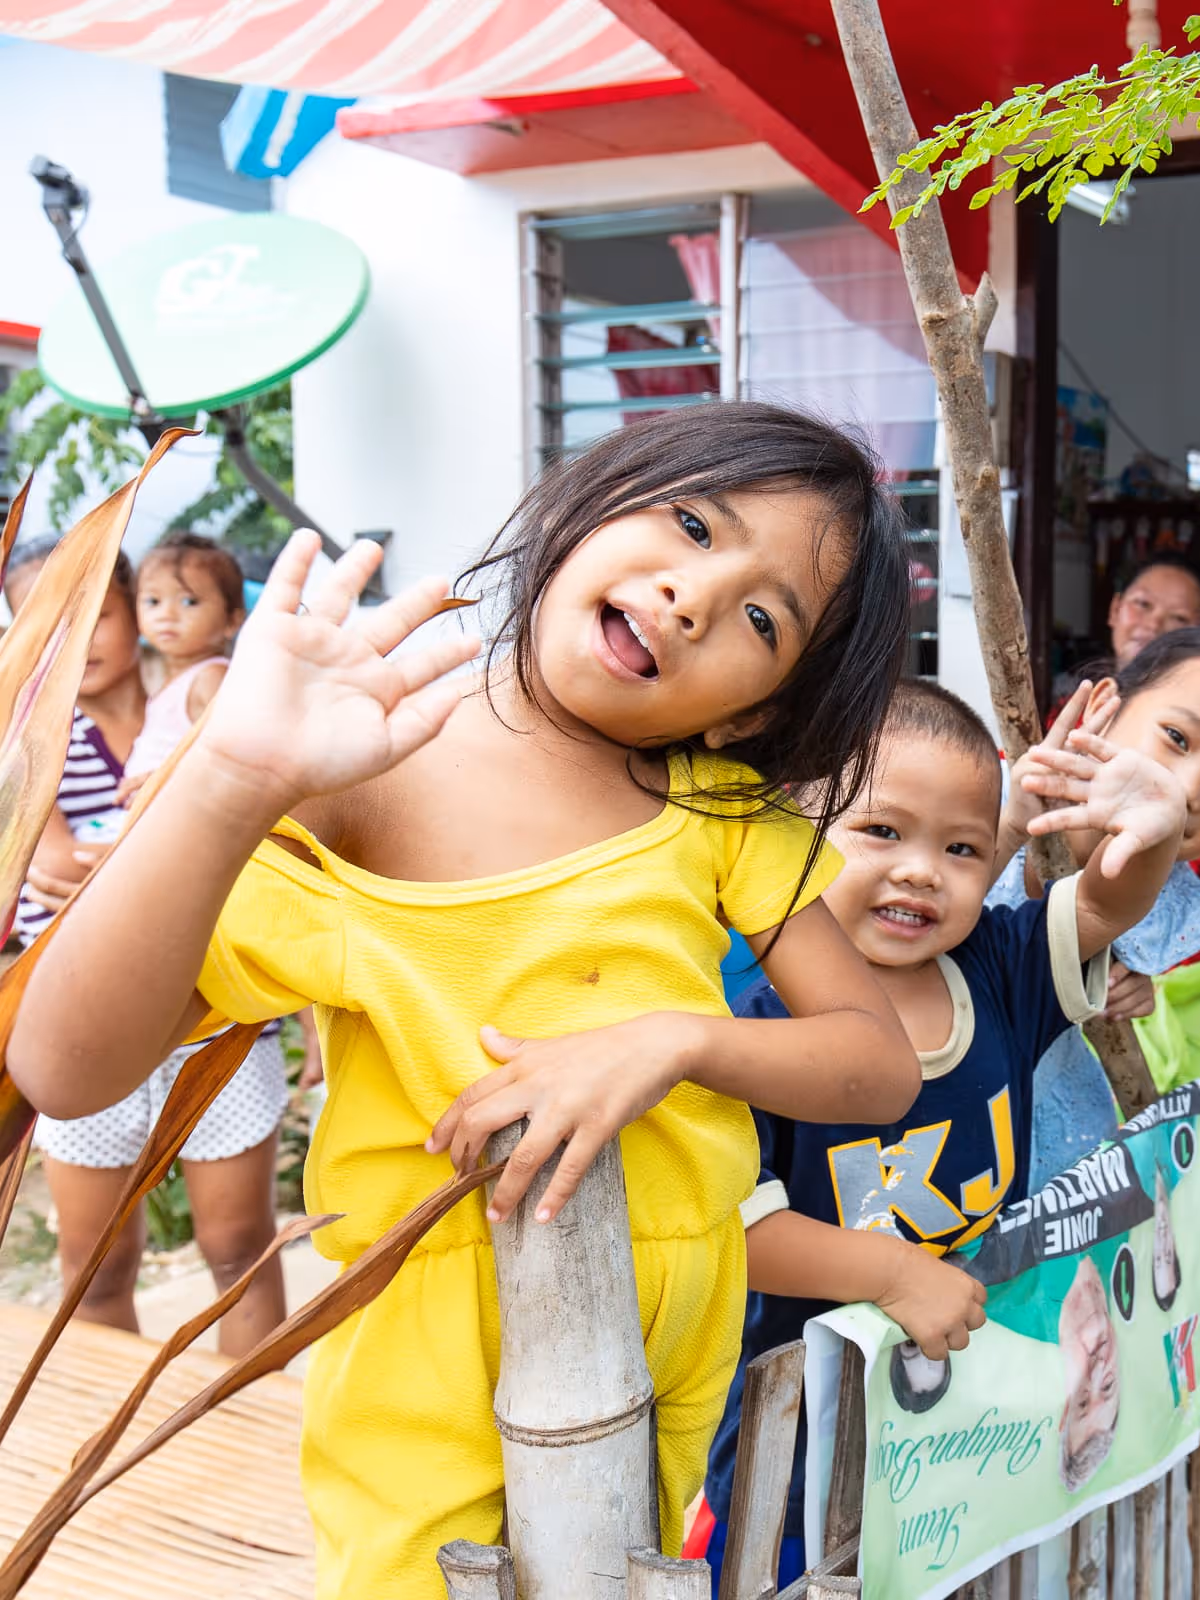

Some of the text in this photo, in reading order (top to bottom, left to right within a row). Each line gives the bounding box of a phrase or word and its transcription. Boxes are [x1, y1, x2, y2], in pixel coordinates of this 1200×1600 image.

[1043, 1206, 1103, 1256] JUNIE
[928, 1406, 1053, 1476] Padayon
[898, 1501, 969, 1572] Team
